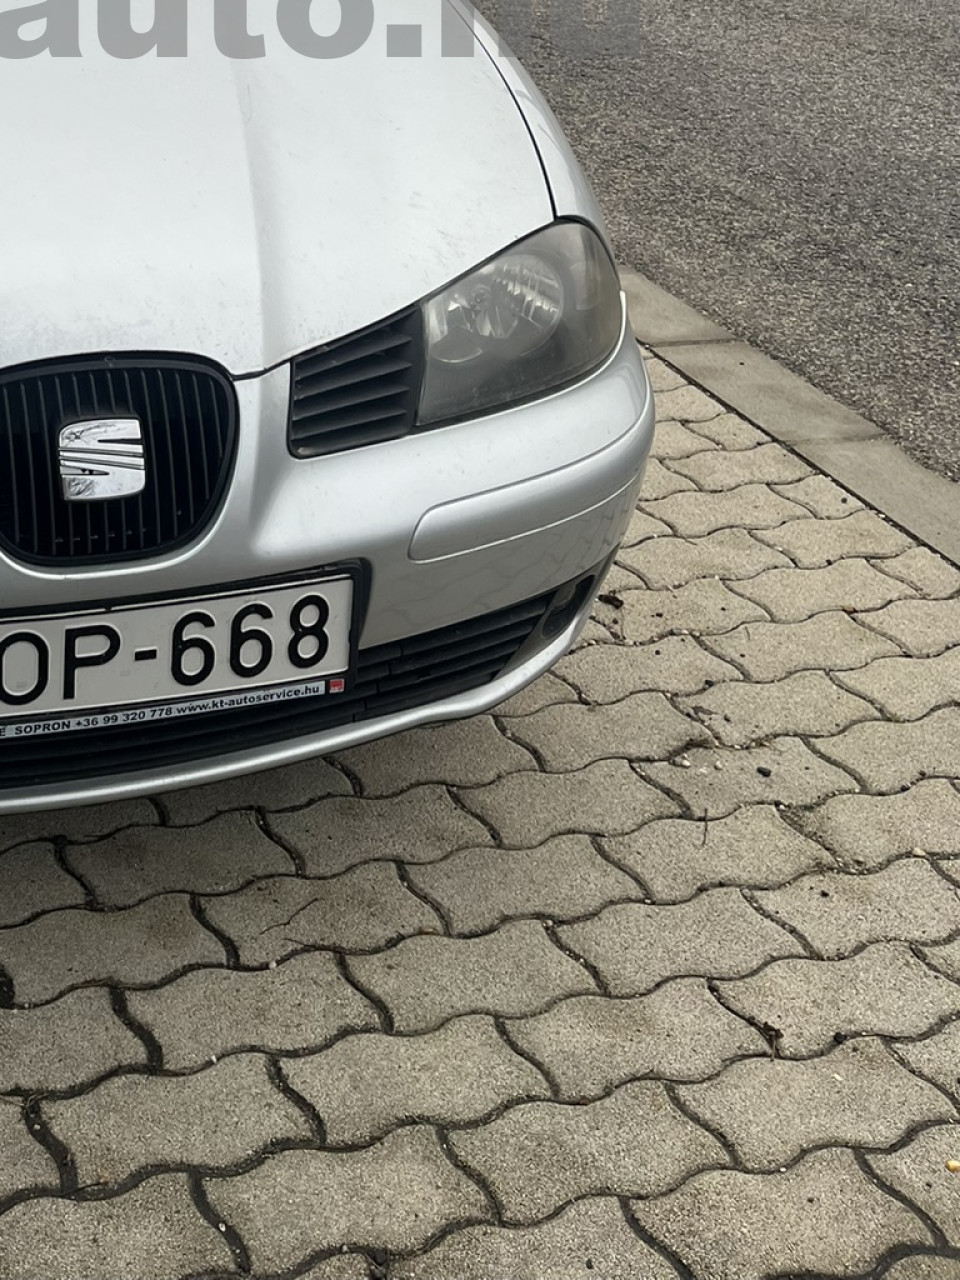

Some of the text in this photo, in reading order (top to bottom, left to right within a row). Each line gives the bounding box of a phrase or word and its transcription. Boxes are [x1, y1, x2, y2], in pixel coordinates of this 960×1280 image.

[14, 720, 71, 736] SOPRON
[74, 718, 99, 728] +36
[103, 714, 119, 724] 99
[122, 710, 146, 721] 320
[150, 706, 173, 717] 778
[176, 685, 320, 715] www.kt-autoservice.hu
